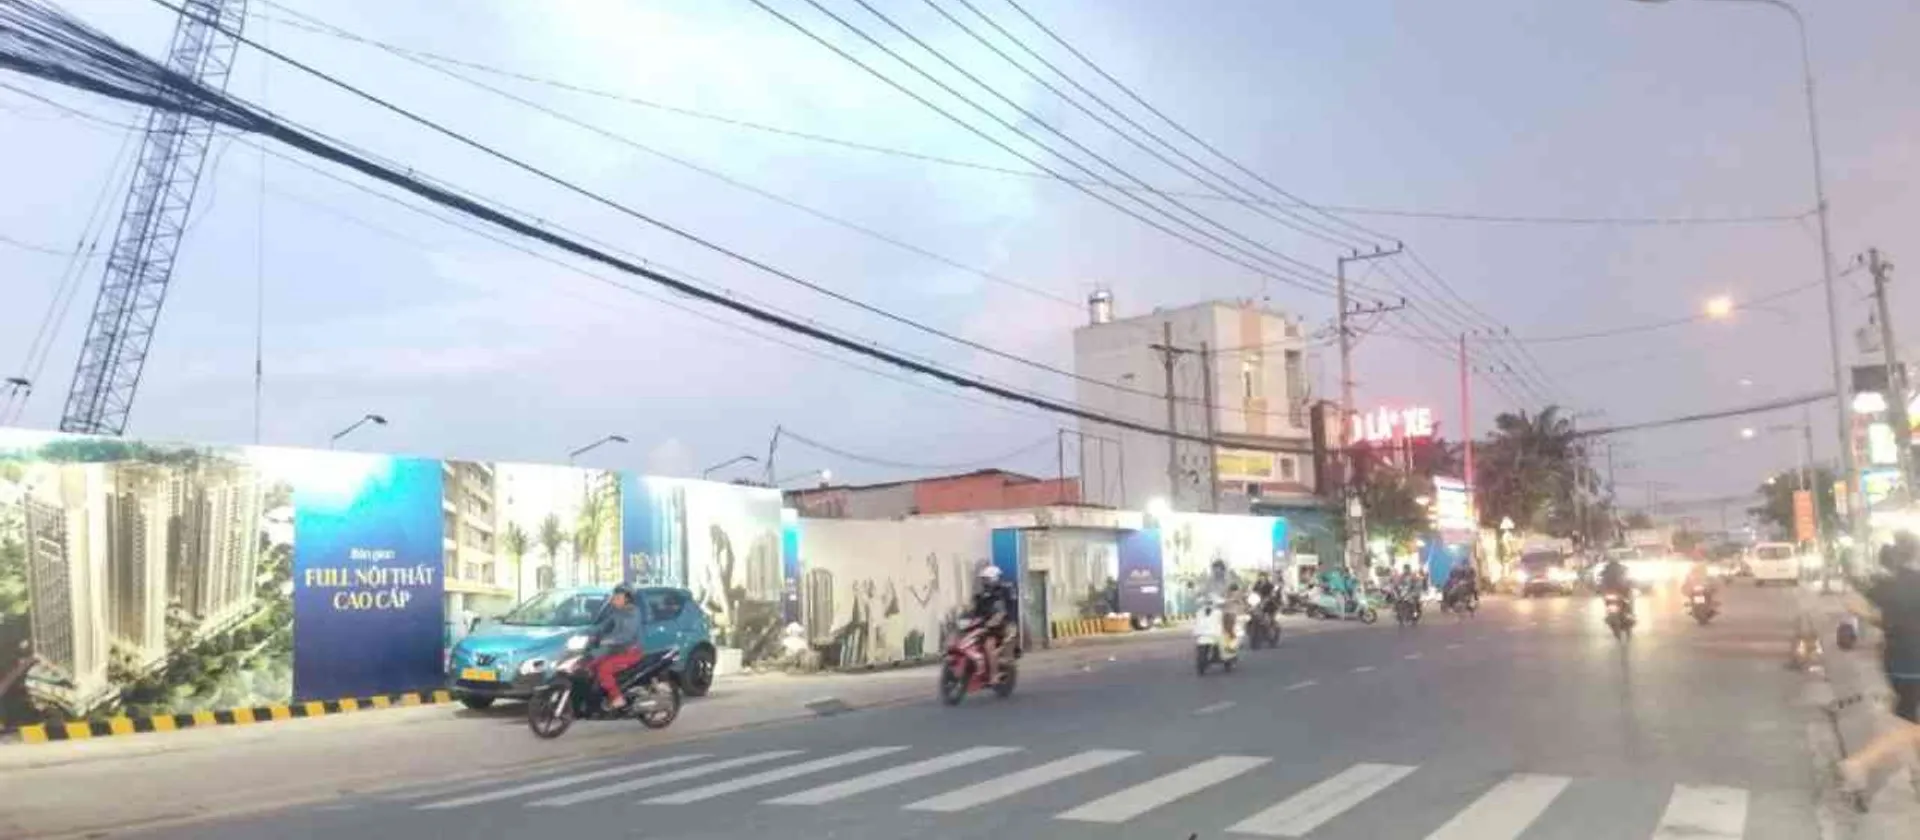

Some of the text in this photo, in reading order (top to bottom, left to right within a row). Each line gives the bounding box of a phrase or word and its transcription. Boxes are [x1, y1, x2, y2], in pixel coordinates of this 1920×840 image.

[1402, 407, 1431, 437] XE
[305, 567, 349, 587] FULL
[388, 562, 435, 586] THẤT
[334, 586, 411, 610] CAO CẤP
